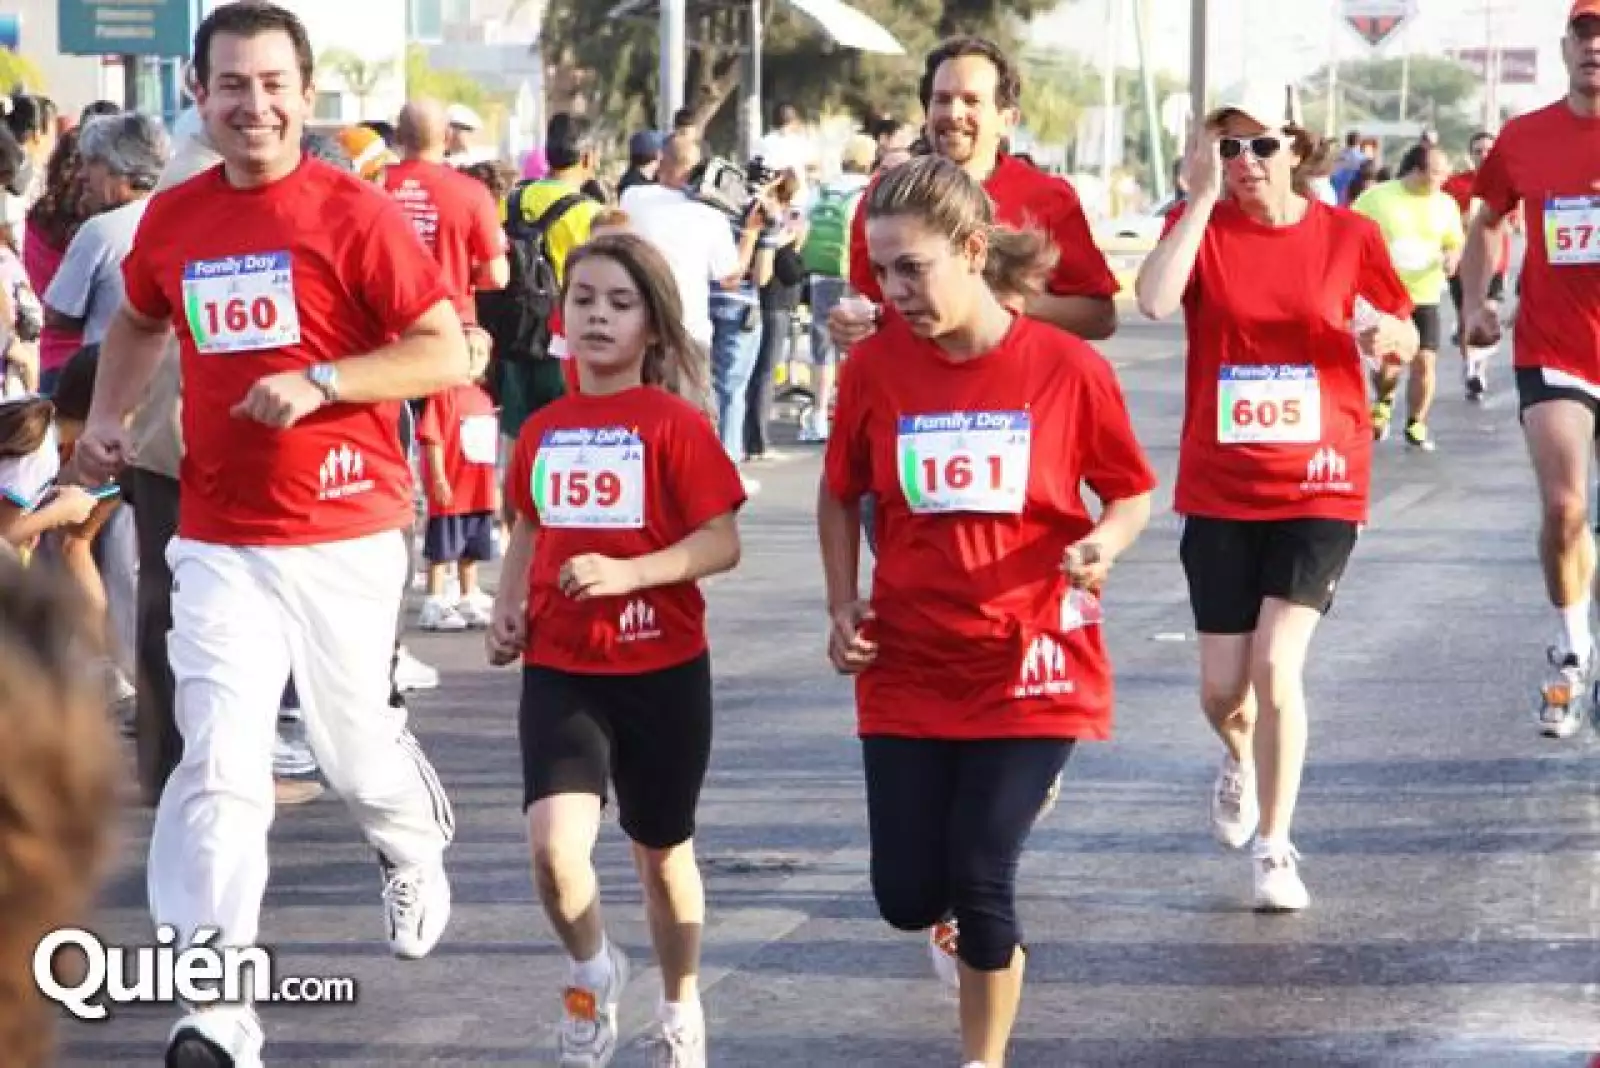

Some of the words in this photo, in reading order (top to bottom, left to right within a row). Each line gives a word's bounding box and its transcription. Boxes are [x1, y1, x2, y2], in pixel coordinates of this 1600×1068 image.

[1556, 225, 1600, 251] 57
[194, 256, 243, 278] Family
[244, 253, 277, 273] Day
[205, 296, 277, 335] 160
[913, 412, 974, 433] Family
[976, 411, 1010, 431] Day
[1233, 399, 1301, 427] 605
[549, 427, 598, 448] Family
[922, 455, 1002, 493] 161
[550, 470, 621, 506] 159
